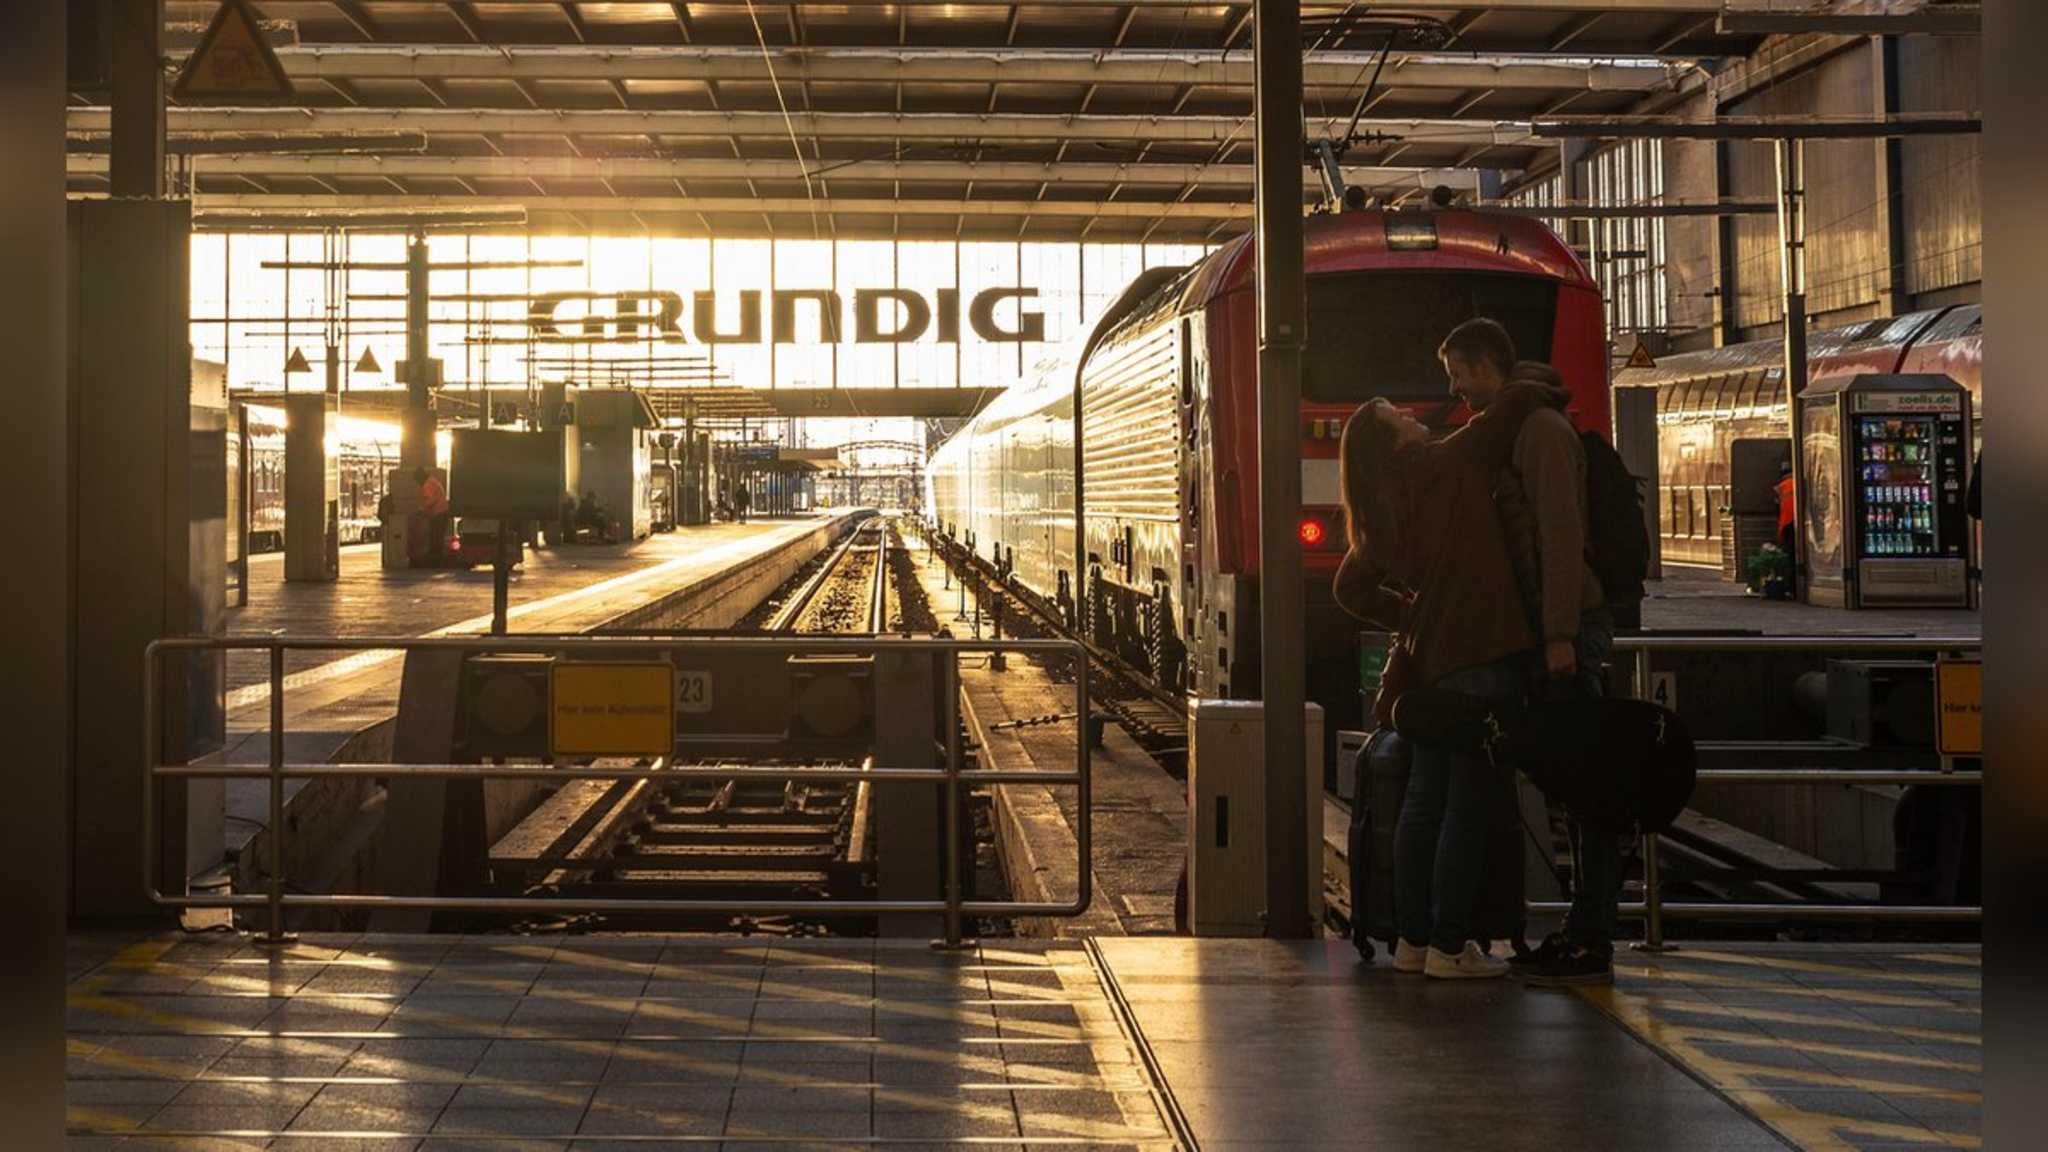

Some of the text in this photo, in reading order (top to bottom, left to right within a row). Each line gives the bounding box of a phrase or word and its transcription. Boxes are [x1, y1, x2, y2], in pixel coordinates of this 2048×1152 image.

[528, 287, 1044, 344] GRUNDIG
[558, 403, 571, 421] A
[680, 677, 704, 703] 23
